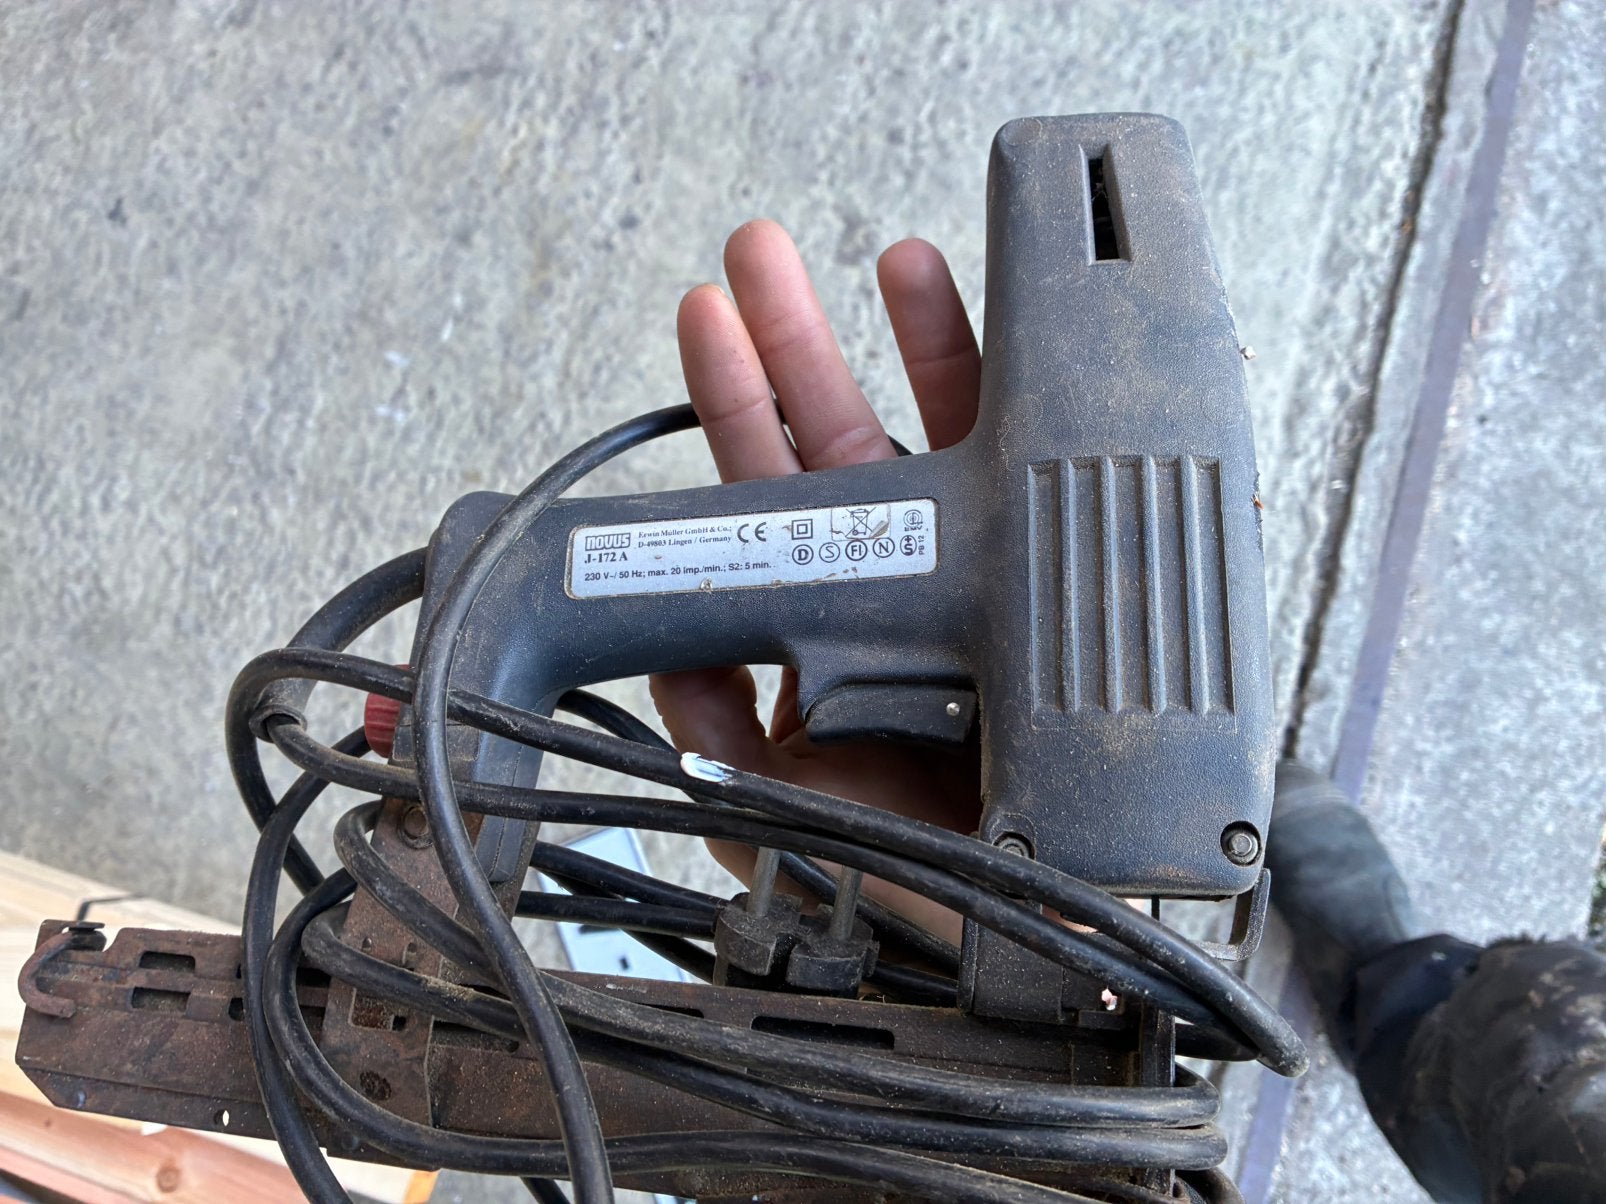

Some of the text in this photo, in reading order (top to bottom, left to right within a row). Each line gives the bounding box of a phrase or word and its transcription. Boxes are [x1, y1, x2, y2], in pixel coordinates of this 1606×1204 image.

[685, 527, 708, 535] GmbH
[668, 538, 692, 546] Lingen
[699, 535, 732, 544] Germany
[618, 552, 629, 562] A
[584, 572, 601, 581] 230
[619, 570, 630, 579] 50
[631, 569, 646, 578] Hz;
[647, 568, 669, 577] max.
[670, 566, 681, 575] 20
[728, 563, 743, 571] S2:
[745, 562, 751, 570] 5
[752, 561, 772, 569] min.
